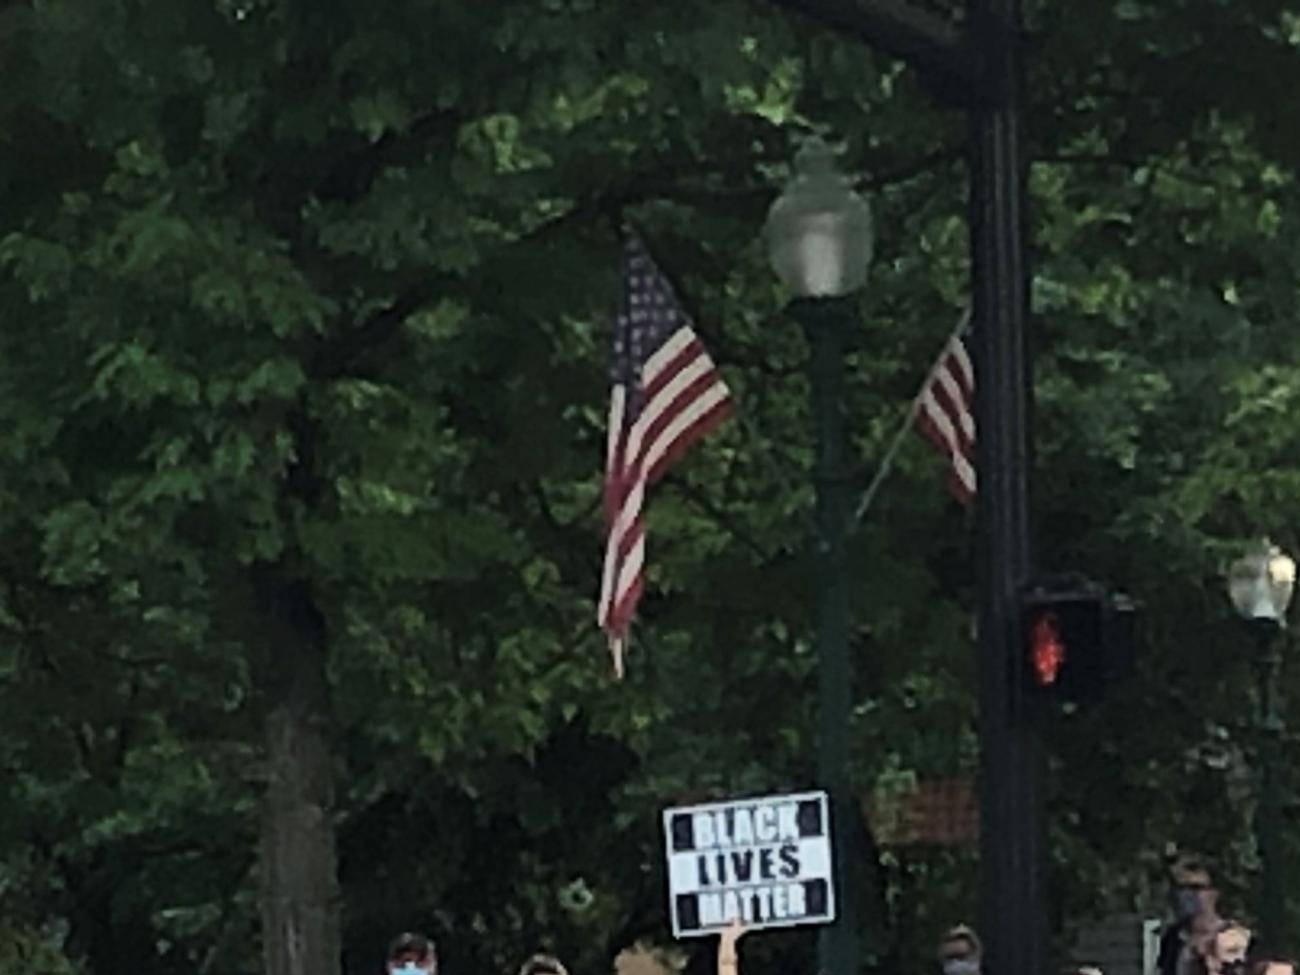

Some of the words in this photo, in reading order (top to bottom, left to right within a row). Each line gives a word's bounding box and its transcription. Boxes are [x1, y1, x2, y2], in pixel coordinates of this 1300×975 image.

[692, 801, 799, 848] BLACK
[698, 845, 802, 885] LIVES
[699, 885, 806, 927] MATTER
